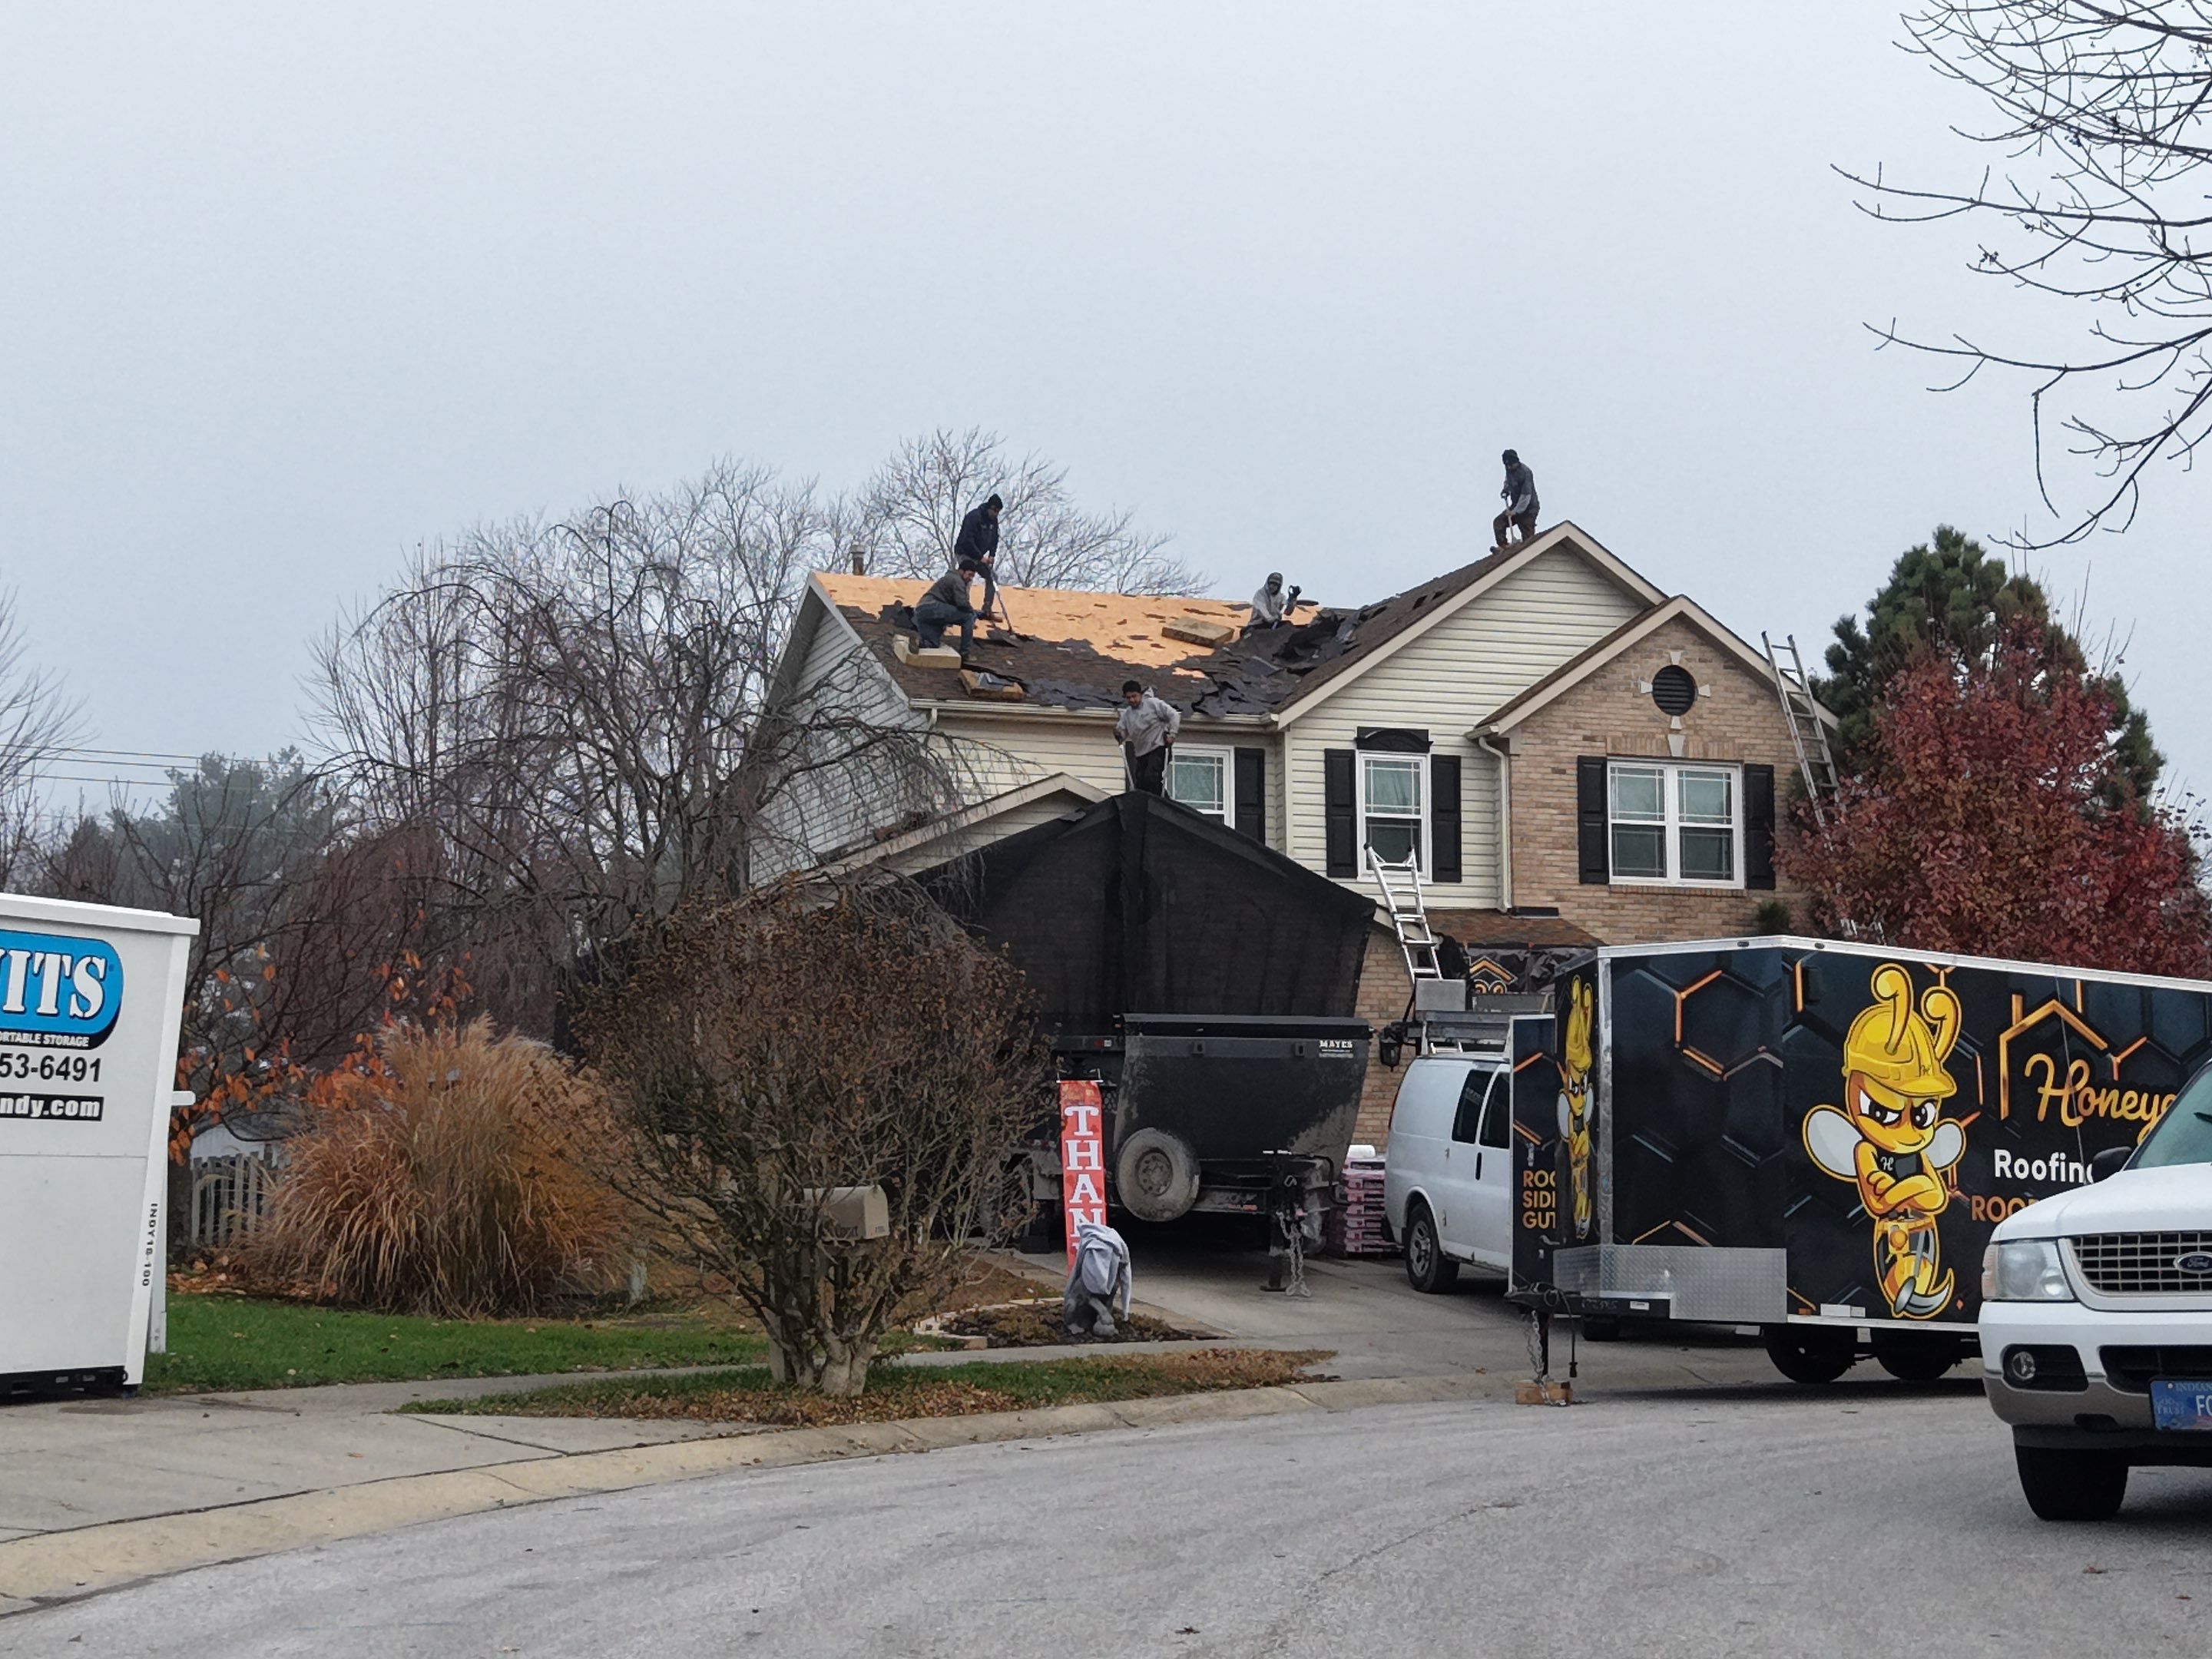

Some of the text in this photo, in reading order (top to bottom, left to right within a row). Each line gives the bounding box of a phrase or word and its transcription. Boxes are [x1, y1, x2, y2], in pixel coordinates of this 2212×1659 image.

[0, 948, 106, 1018] ITS
[43, 1035, 90, 1047] STORAGE
[1320, 1039, 1353, 1048] MAYES
[0, 1052, 101, 1082] 53-6491
[1064, 1106, 1103, 1250] THAN
[1971, 1195, 2040, 1223] ROO
